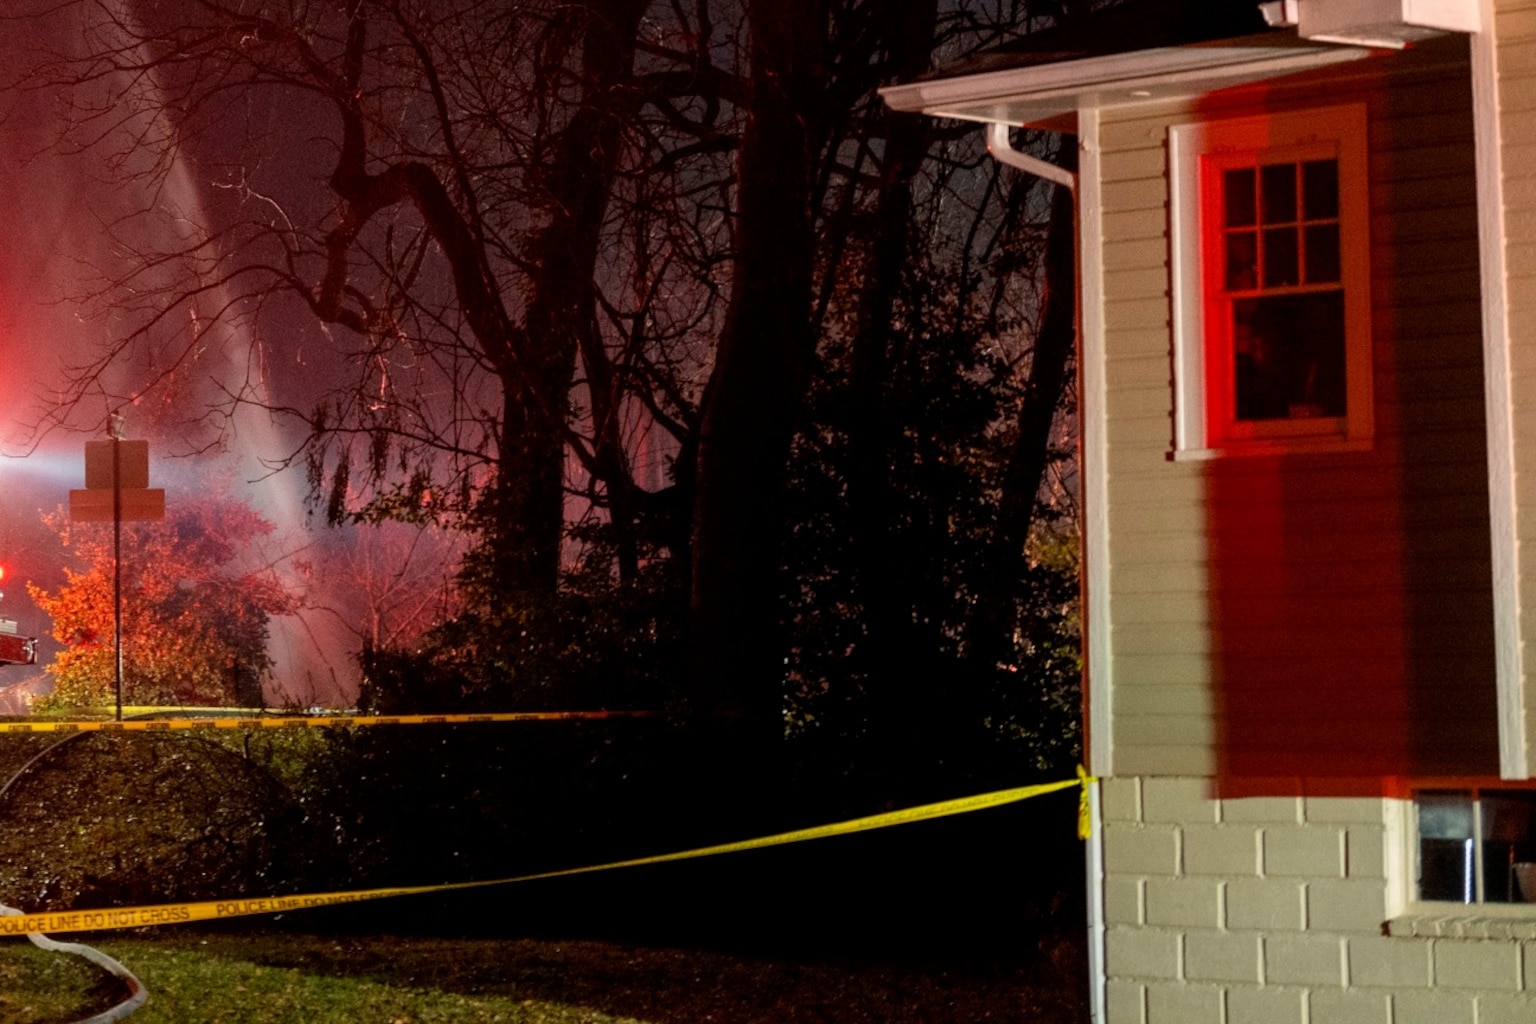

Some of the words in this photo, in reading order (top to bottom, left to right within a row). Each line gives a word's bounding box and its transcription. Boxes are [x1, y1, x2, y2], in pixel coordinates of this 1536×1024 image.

[216, 901, 266, 916] POLICE
[49, 914, 81, 931] LINE
[84, 912, 104, 928] DO
[108, 910, 136, 926] NOT
[140, 907, 190, 923] CROSS
